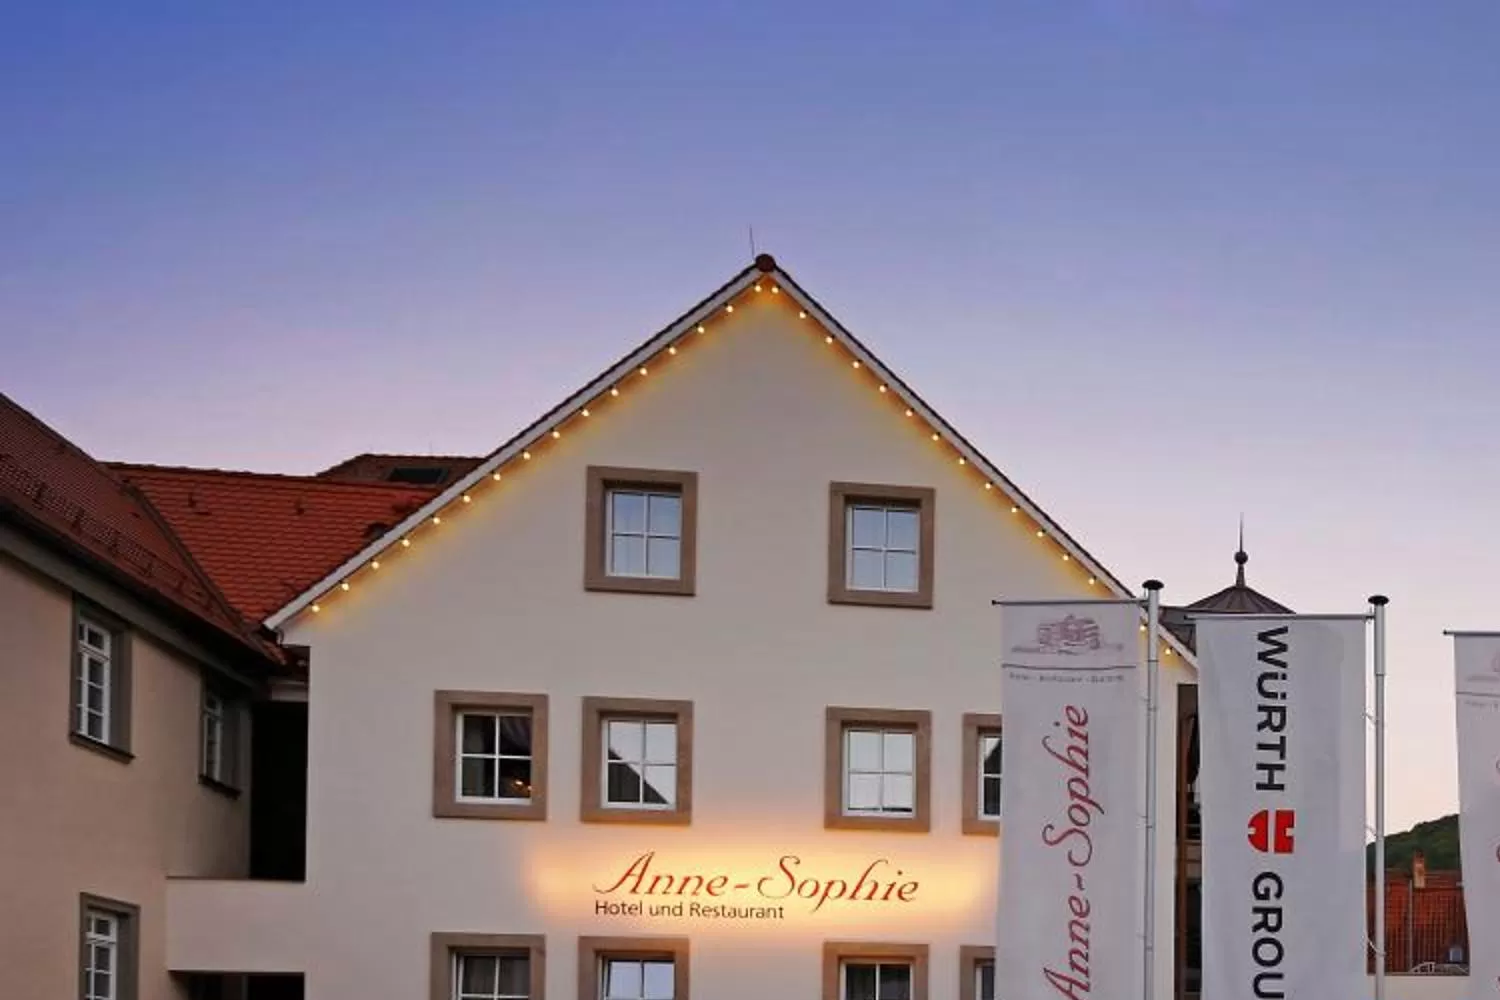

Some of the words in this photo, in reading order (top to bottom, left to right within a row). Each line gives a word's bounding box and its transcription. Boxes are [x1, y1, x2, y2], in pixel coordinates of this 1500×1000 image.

[1254, 625, 1289, 793] WÜRTH
[593, 851, 919, 913] Anne-Sophie
[595, 901, 643, 916] Hotel
[648, 902, 684, 918] und
[689, 903, 784, 919] Restaurant
